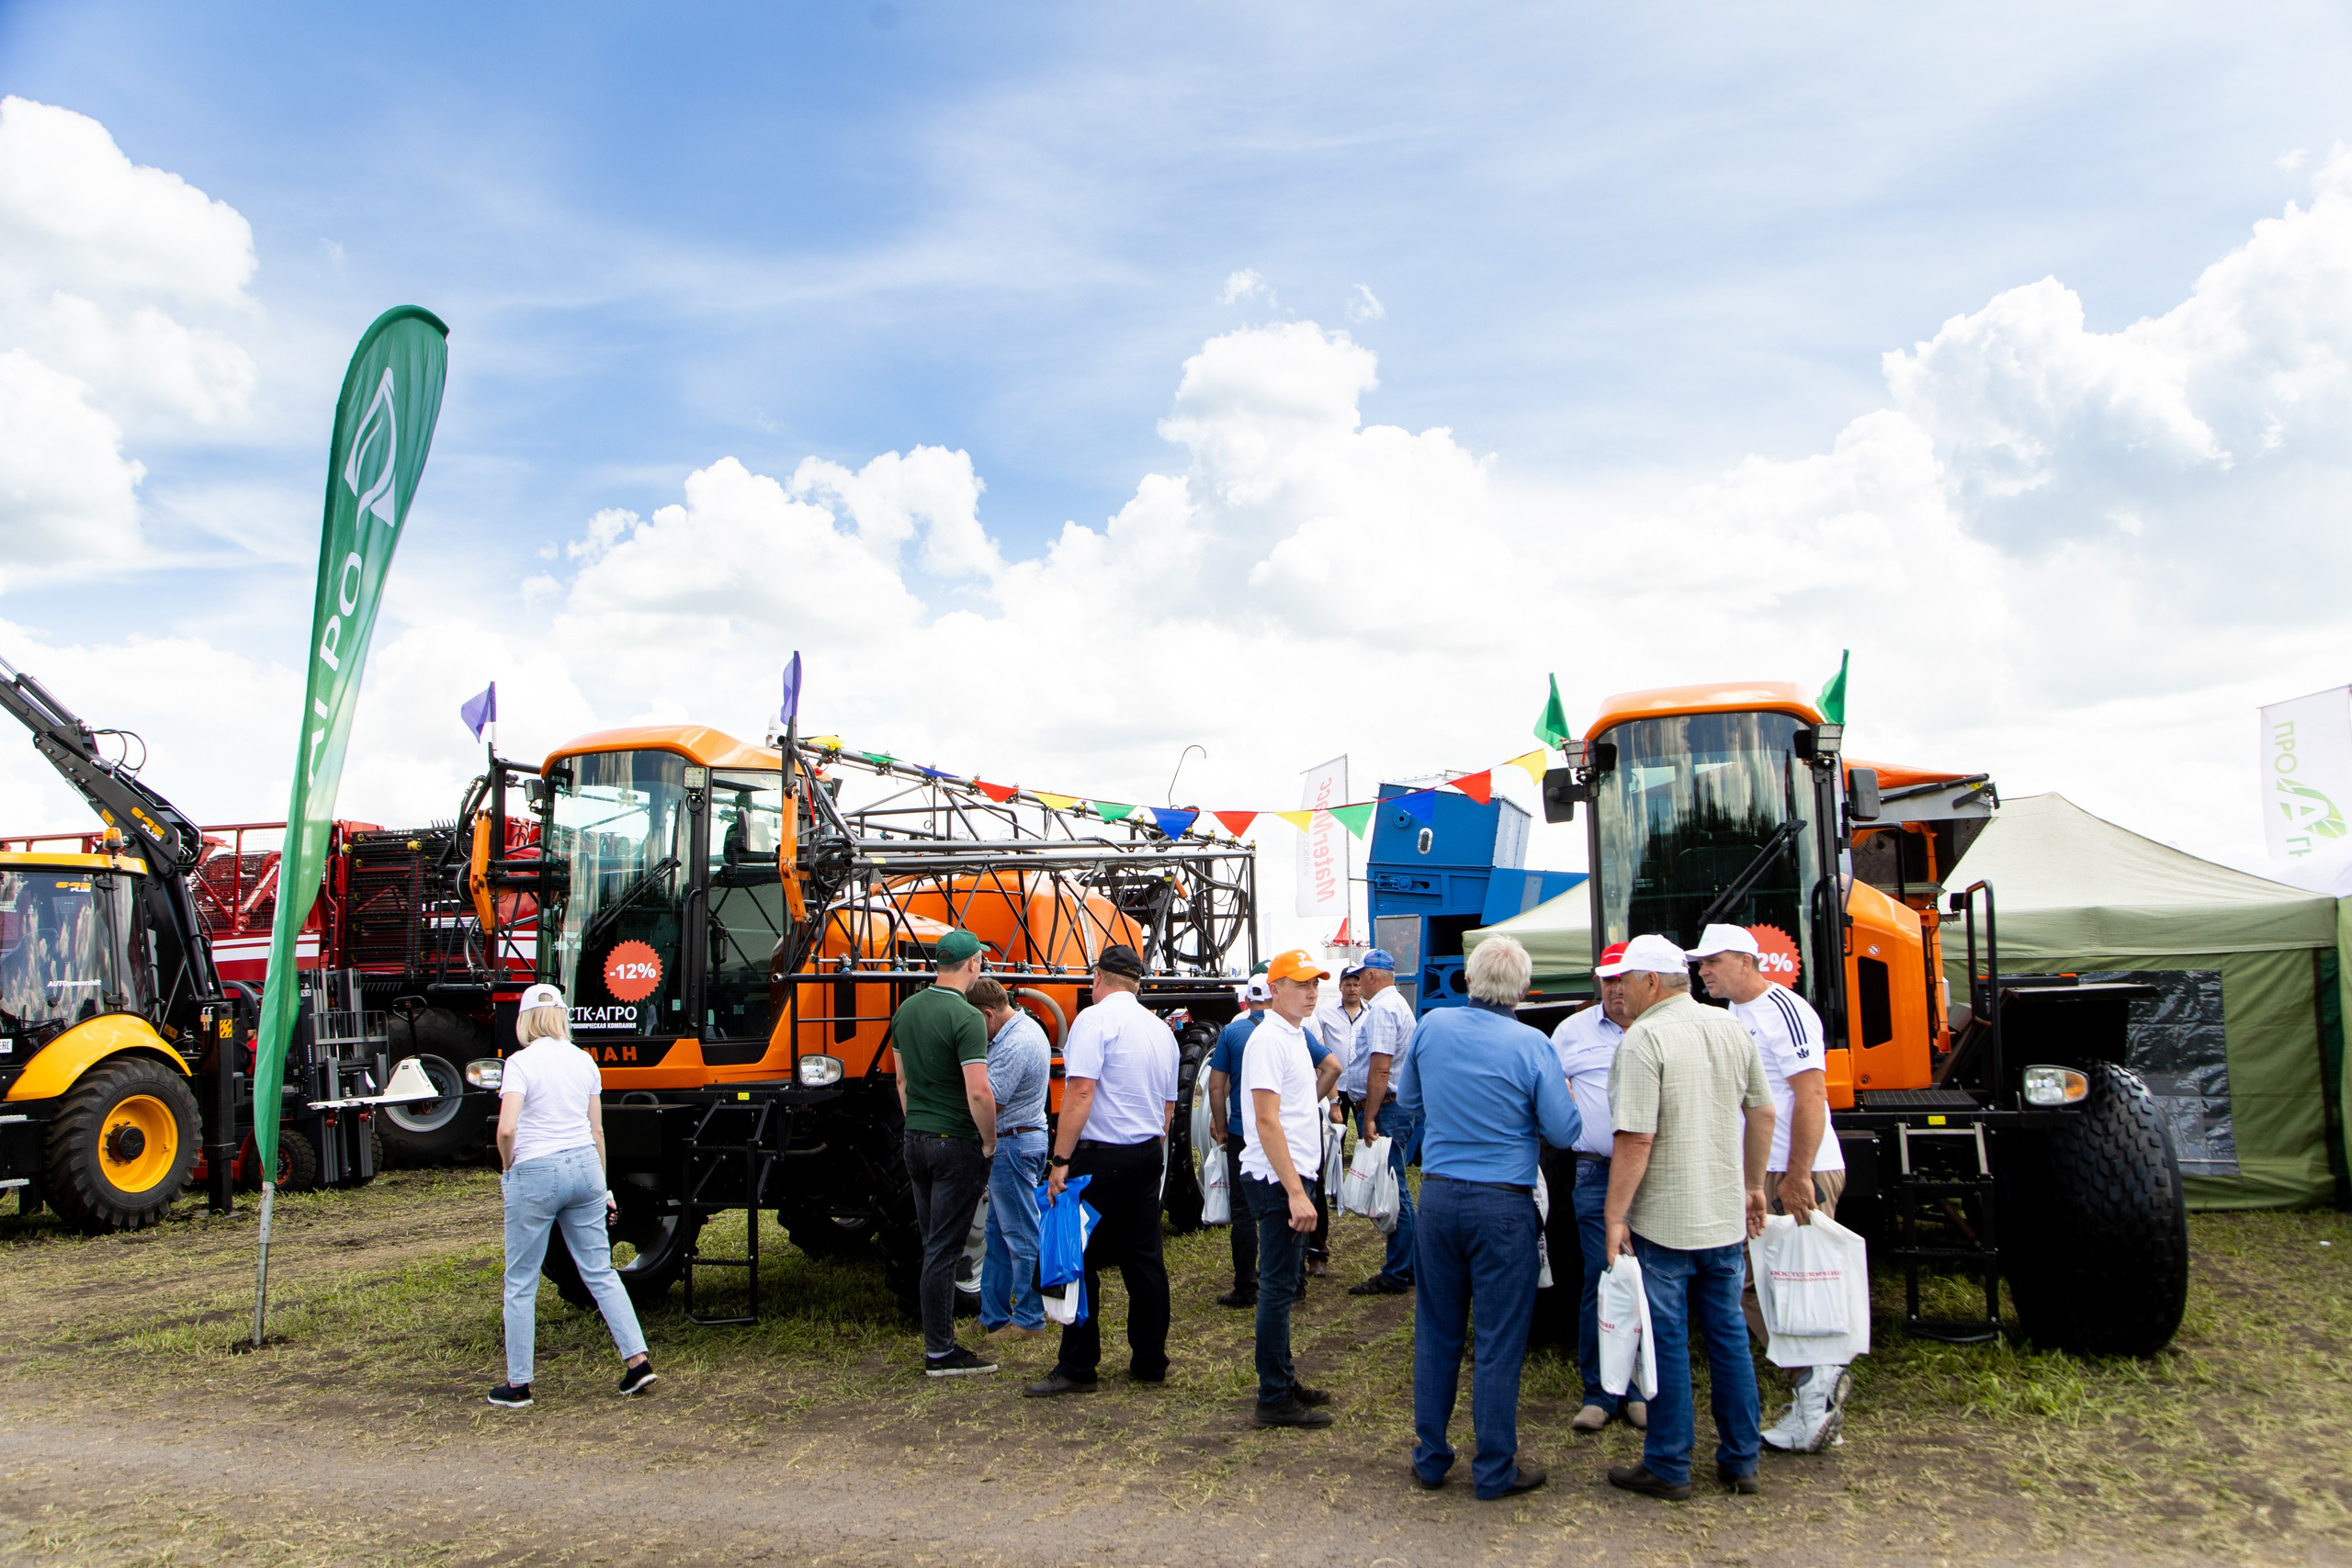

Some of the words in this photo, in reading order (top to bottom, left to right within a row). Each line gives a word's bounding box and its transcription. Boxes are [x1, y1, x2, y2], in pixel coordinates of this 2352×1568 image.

[130, 807, 165, 838] 642
[141, 823, 162, 842] PLUS
[55, 881, 92, 889] 642
[609, 962, 657, 980] -12%
[1758, 952, 1793, 973] 2%
[47, 979, 102, 988] AUTOpowershift
[582, 1045, 638, 1062] МАН
